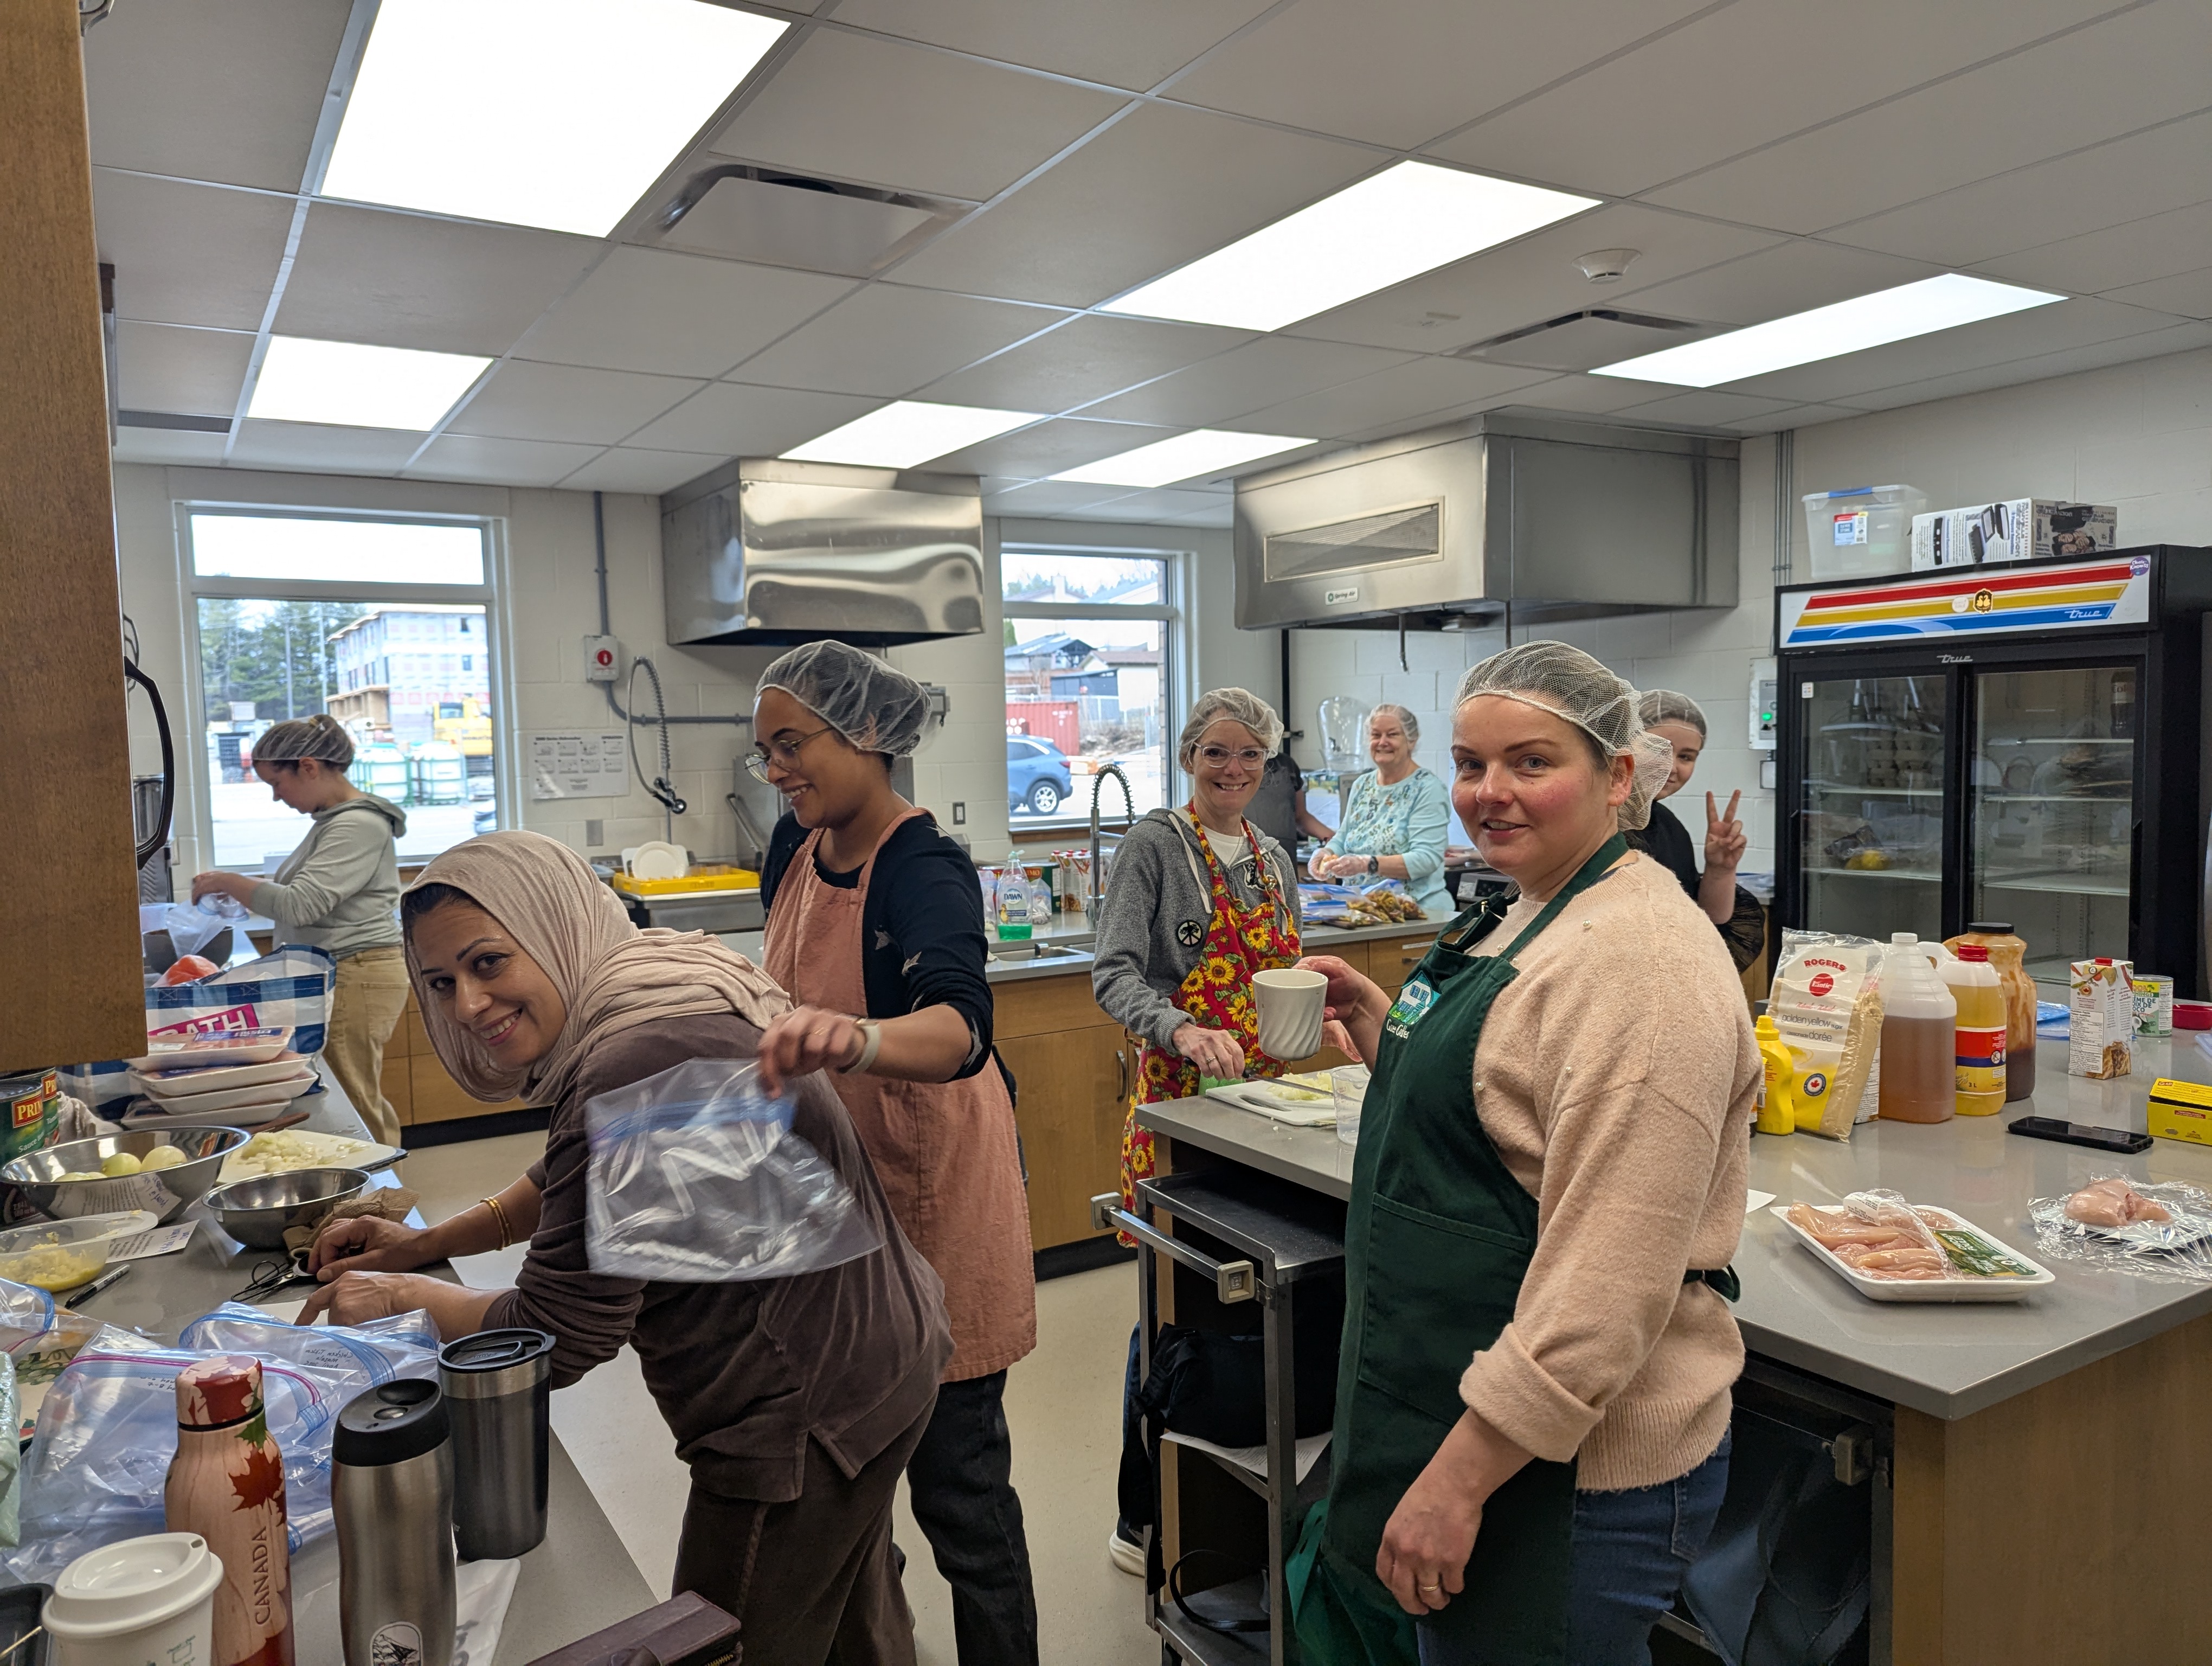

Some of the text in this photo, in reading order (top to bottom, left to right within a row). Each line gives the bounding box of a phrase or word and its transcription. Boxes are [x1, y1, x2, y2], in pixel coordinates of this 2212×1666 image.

[1804, 959, 1847, 972] ROGERS
[156, 1010, 248, 1036] ATH
[1781, 1014, 1806, 1024] golden
[1806, 1017, 1831, 1027] yellow
[1809, 1031, 1832, 1042] dorée
[17, 1100, 43, 1120] PRIM
[18, 1140, 37, 1153] Sauce
[1939, 1233, 1967, 1250] CHICKEN
[1951, 1235, 1977, 1251] POULET
[1232, 1277, 1240, 1287] B
[252, 1525, 271, 1625] CANADA
